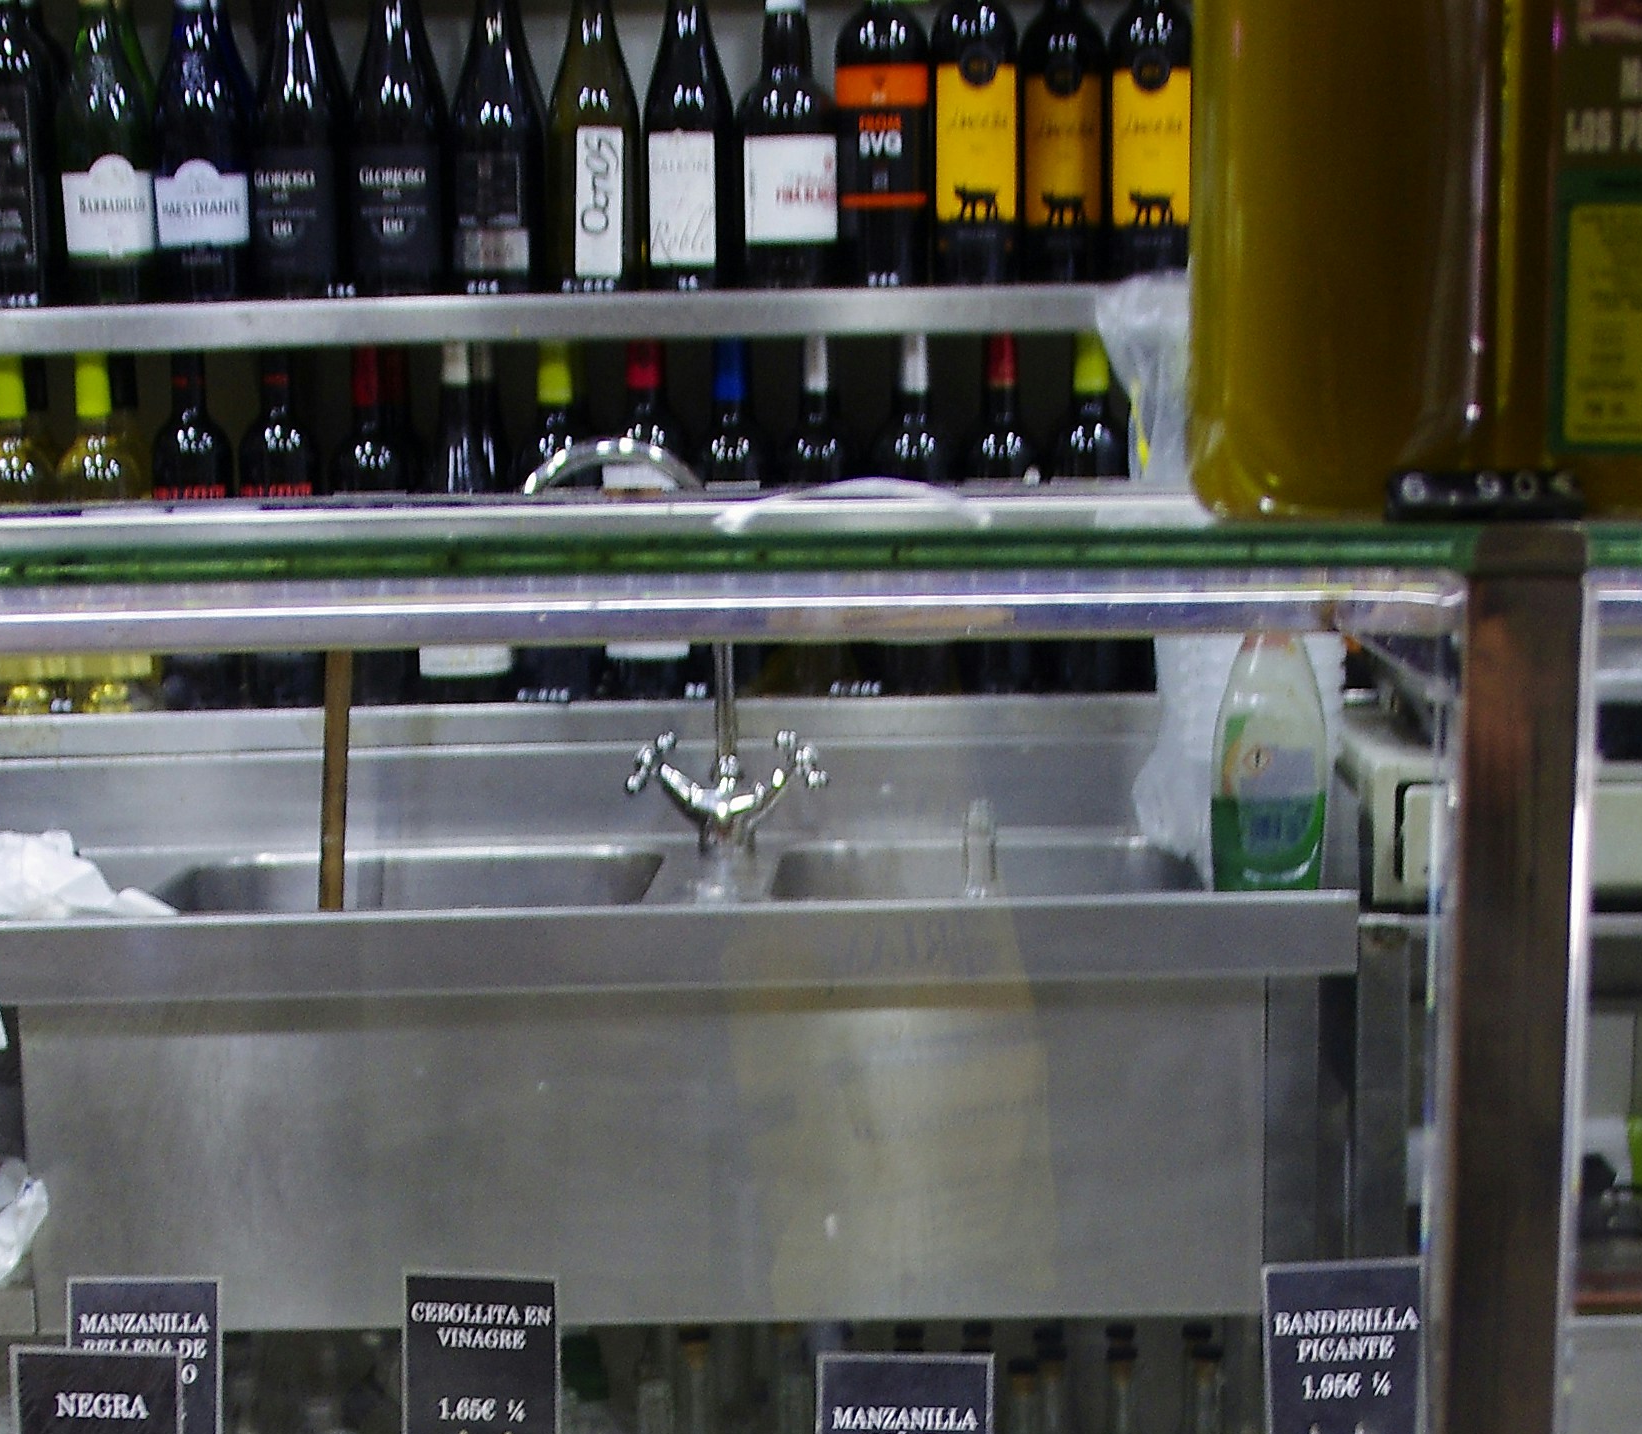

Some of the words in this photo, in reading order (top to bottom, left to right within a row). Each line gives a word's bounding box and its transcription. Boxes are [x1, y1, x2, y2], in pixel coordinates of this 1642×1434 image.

[1565, 107, 1611, 152] LOS
[78, 1312, 210, 1335] MANZANILLA
[411, 1301, 521, 1326] CEBOLLITA
[524, 1305, 553, 1327] EN
[1273, 1305, 1421, 1337] BANDERILLA
[178, 1338, 208, 1360] DE
[437, 1326, 527, 1350] VINAGRE
[1296, 1334, 1397, 1364] PICANTE
[55, 1391, 150, 1420] NEGRA
[831, 1406, 980, 1431] MANZANILLA
